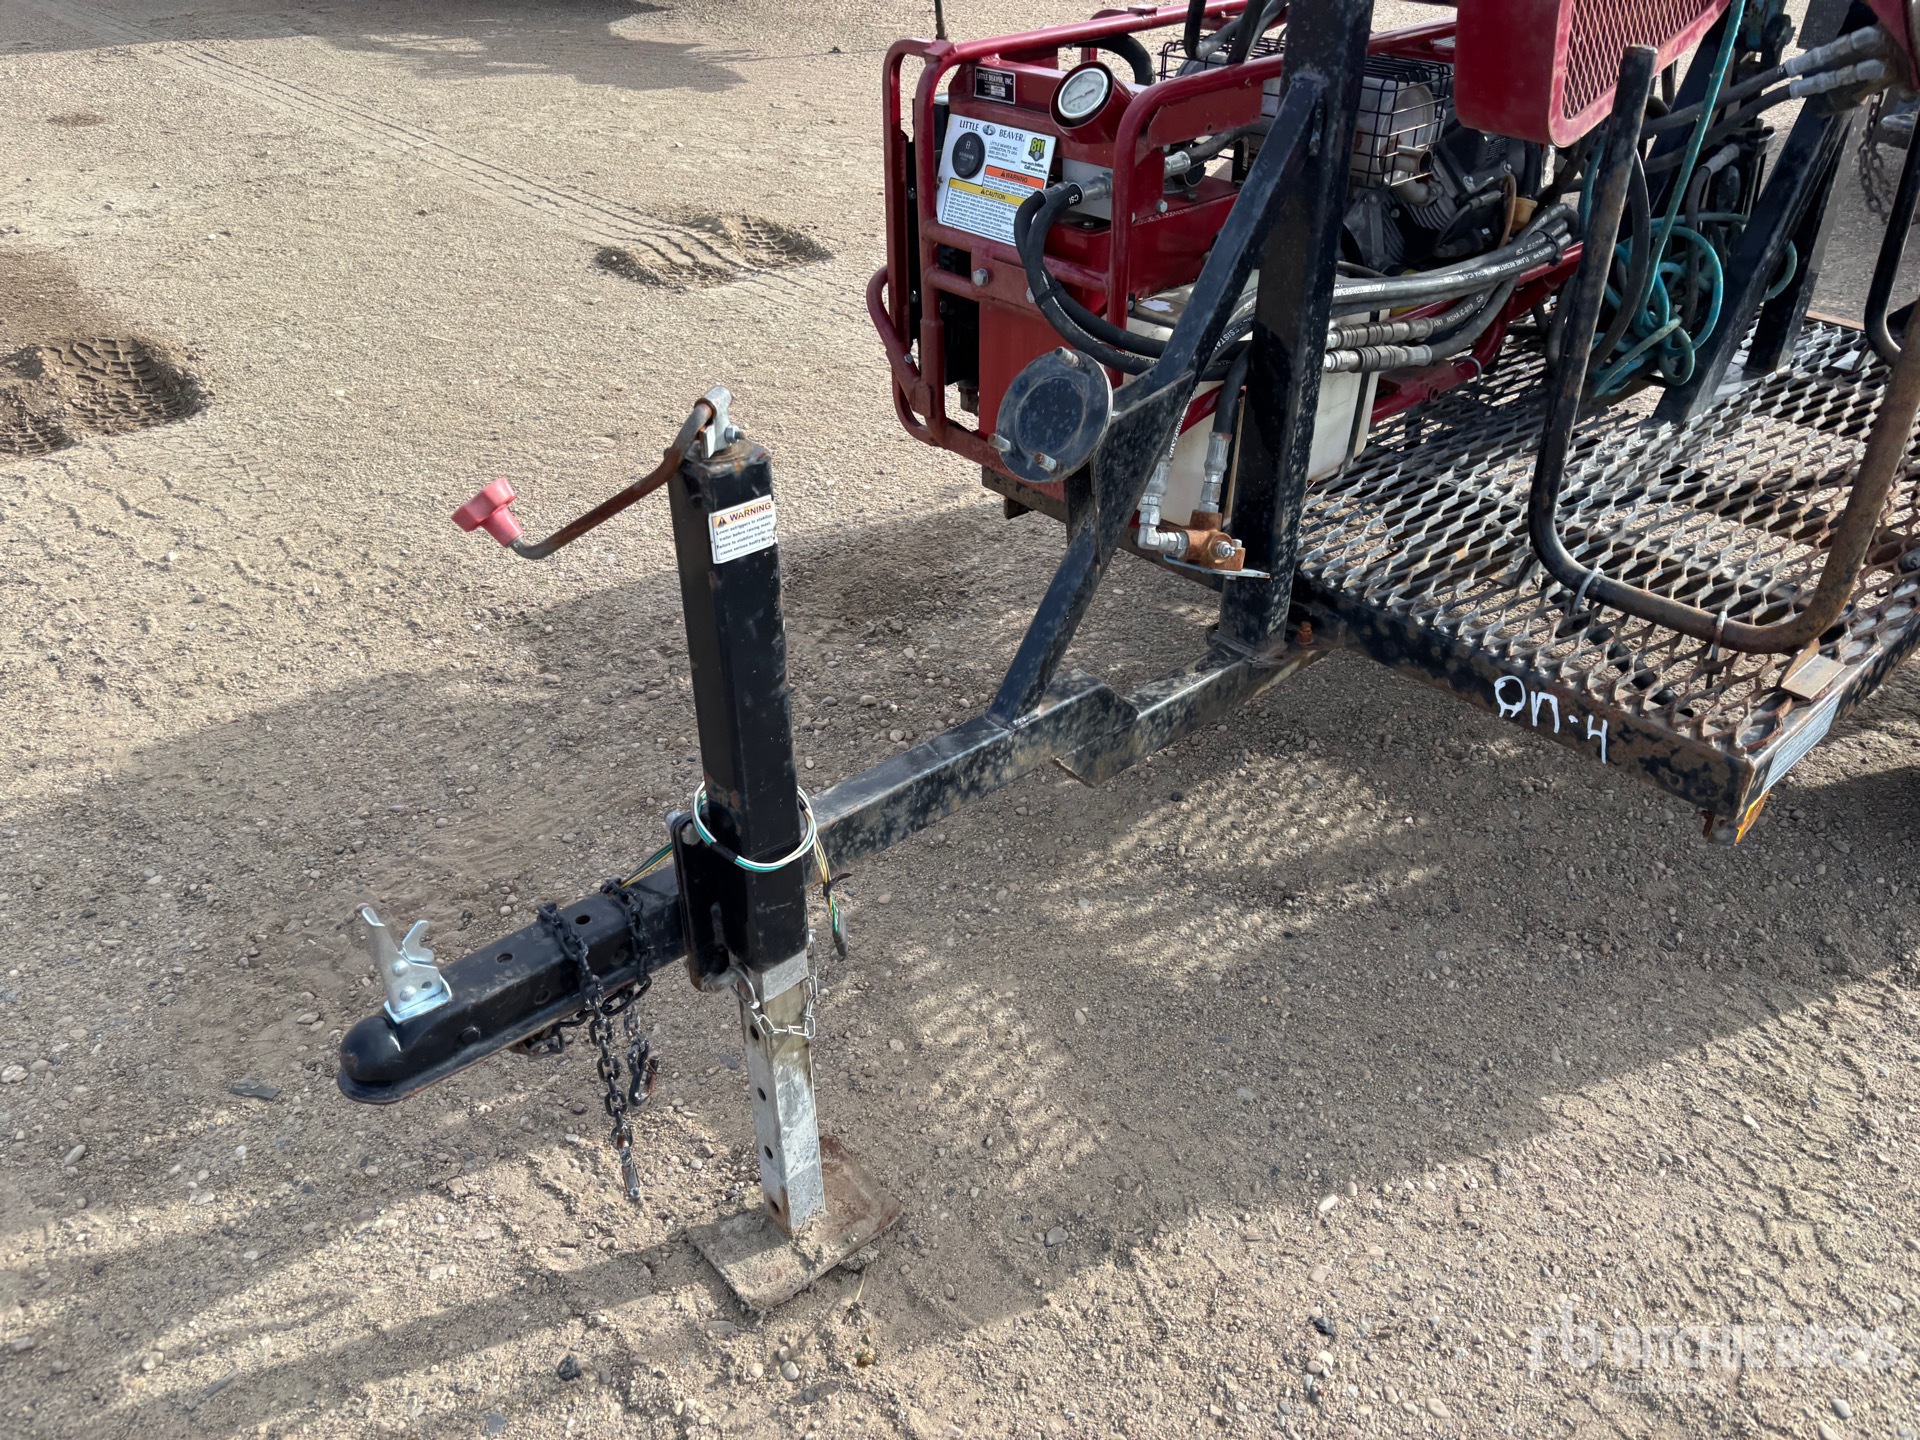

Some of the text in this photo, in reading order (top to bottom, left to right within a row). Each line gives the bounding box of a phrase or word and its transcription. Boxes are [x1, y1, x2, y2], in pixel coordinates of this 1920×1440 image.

[976, 72, 988, 81] LITTLE
[959, 119, 979, 132] LITTLE
[1030, 137, 1046, 154] 811
[1005, 172, 1028, 184] WARNING
[985, 189, 1006, 200] CAUTION
[730, 502, 772, 522] WARNING
